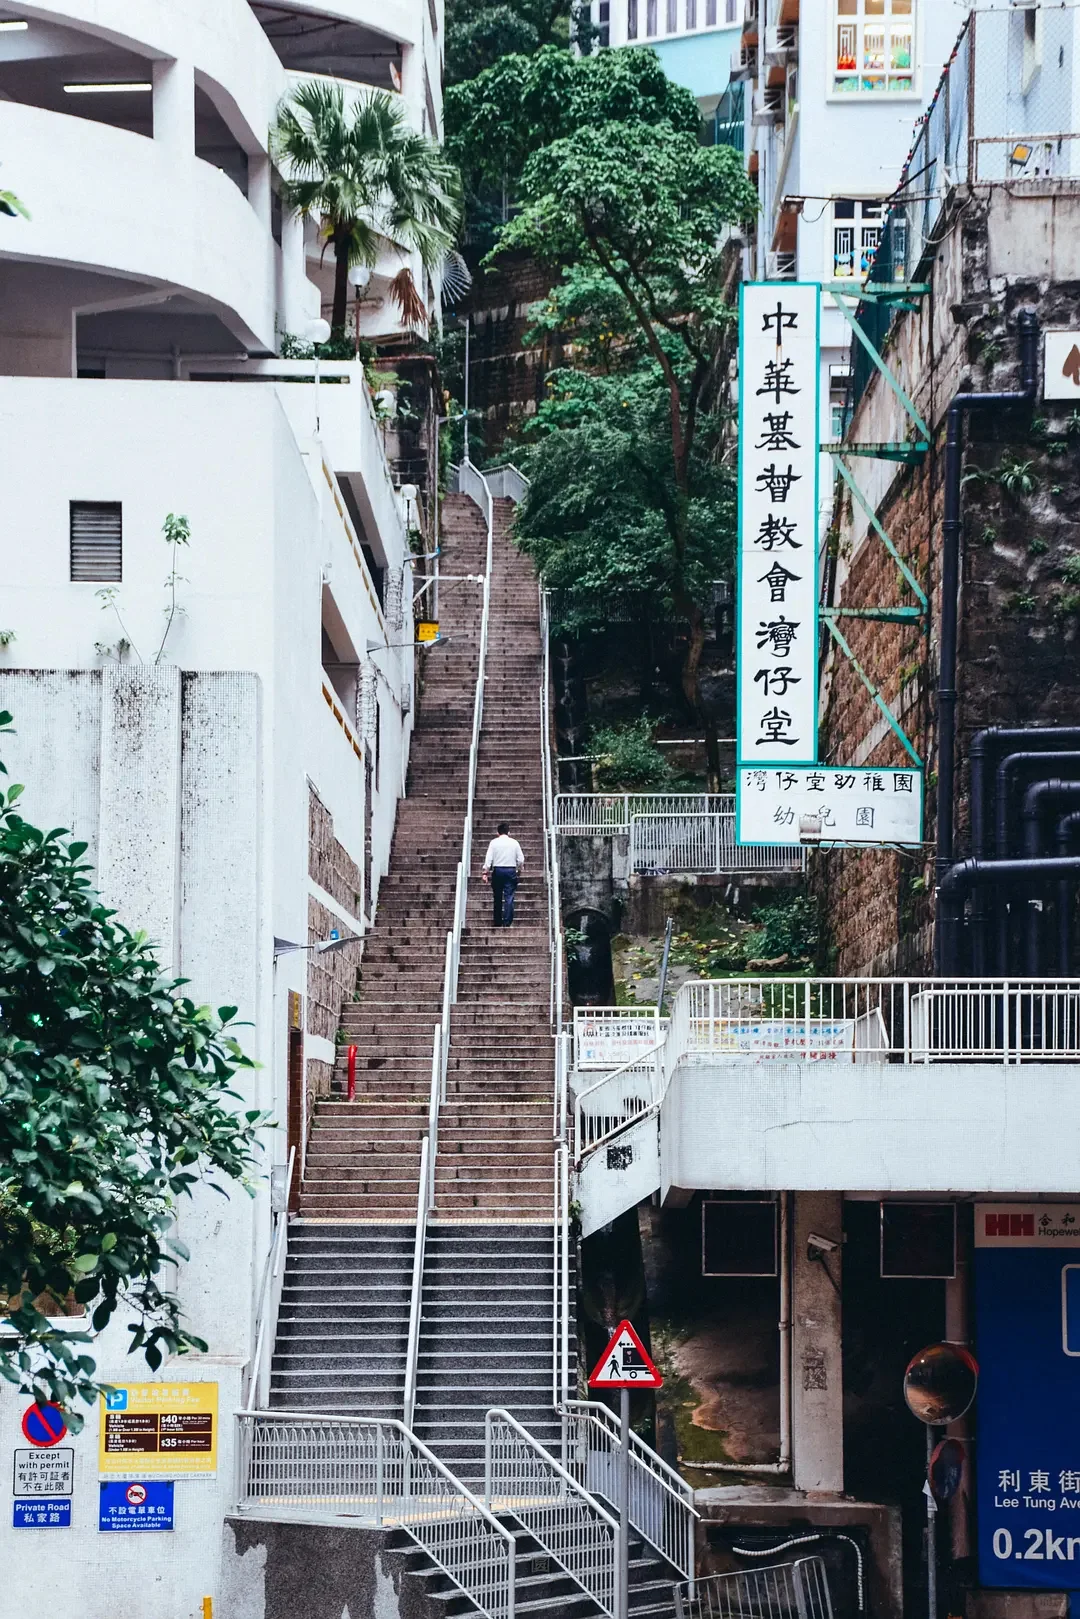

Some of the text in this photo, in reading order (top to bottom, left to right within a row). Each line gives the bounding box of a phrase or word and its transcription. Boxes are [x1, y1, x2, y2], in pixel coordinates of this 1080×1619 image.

[754, 302, 803, 745] 中華基督教會灣仔堂
[747, 770, 913, 792] 灣仔堂幼稚園
[773, 804, 875, 828] 幼兒園
[1038, 1213, 1076, 1227] 合和
[161, 1415, 178, 1424] $40
[161, 1438, 177, 1447] $35
[29, 1452, 60, 1460] Except
[40, 1461, 69, 1470] permit
[18, 1471, 70, 1481] 有許可証者
[998, 1469, 1080, 1493] 利東街
[22, 1482, 64, 1491] 不在此限
[994, 1496, 1019, 1508] Lee
[1022, 1496, 1056, 1511] Tung
[108, 1506, 166, 1515] 不設電單車位
[24, 1513, 60, 1523] 私家路
